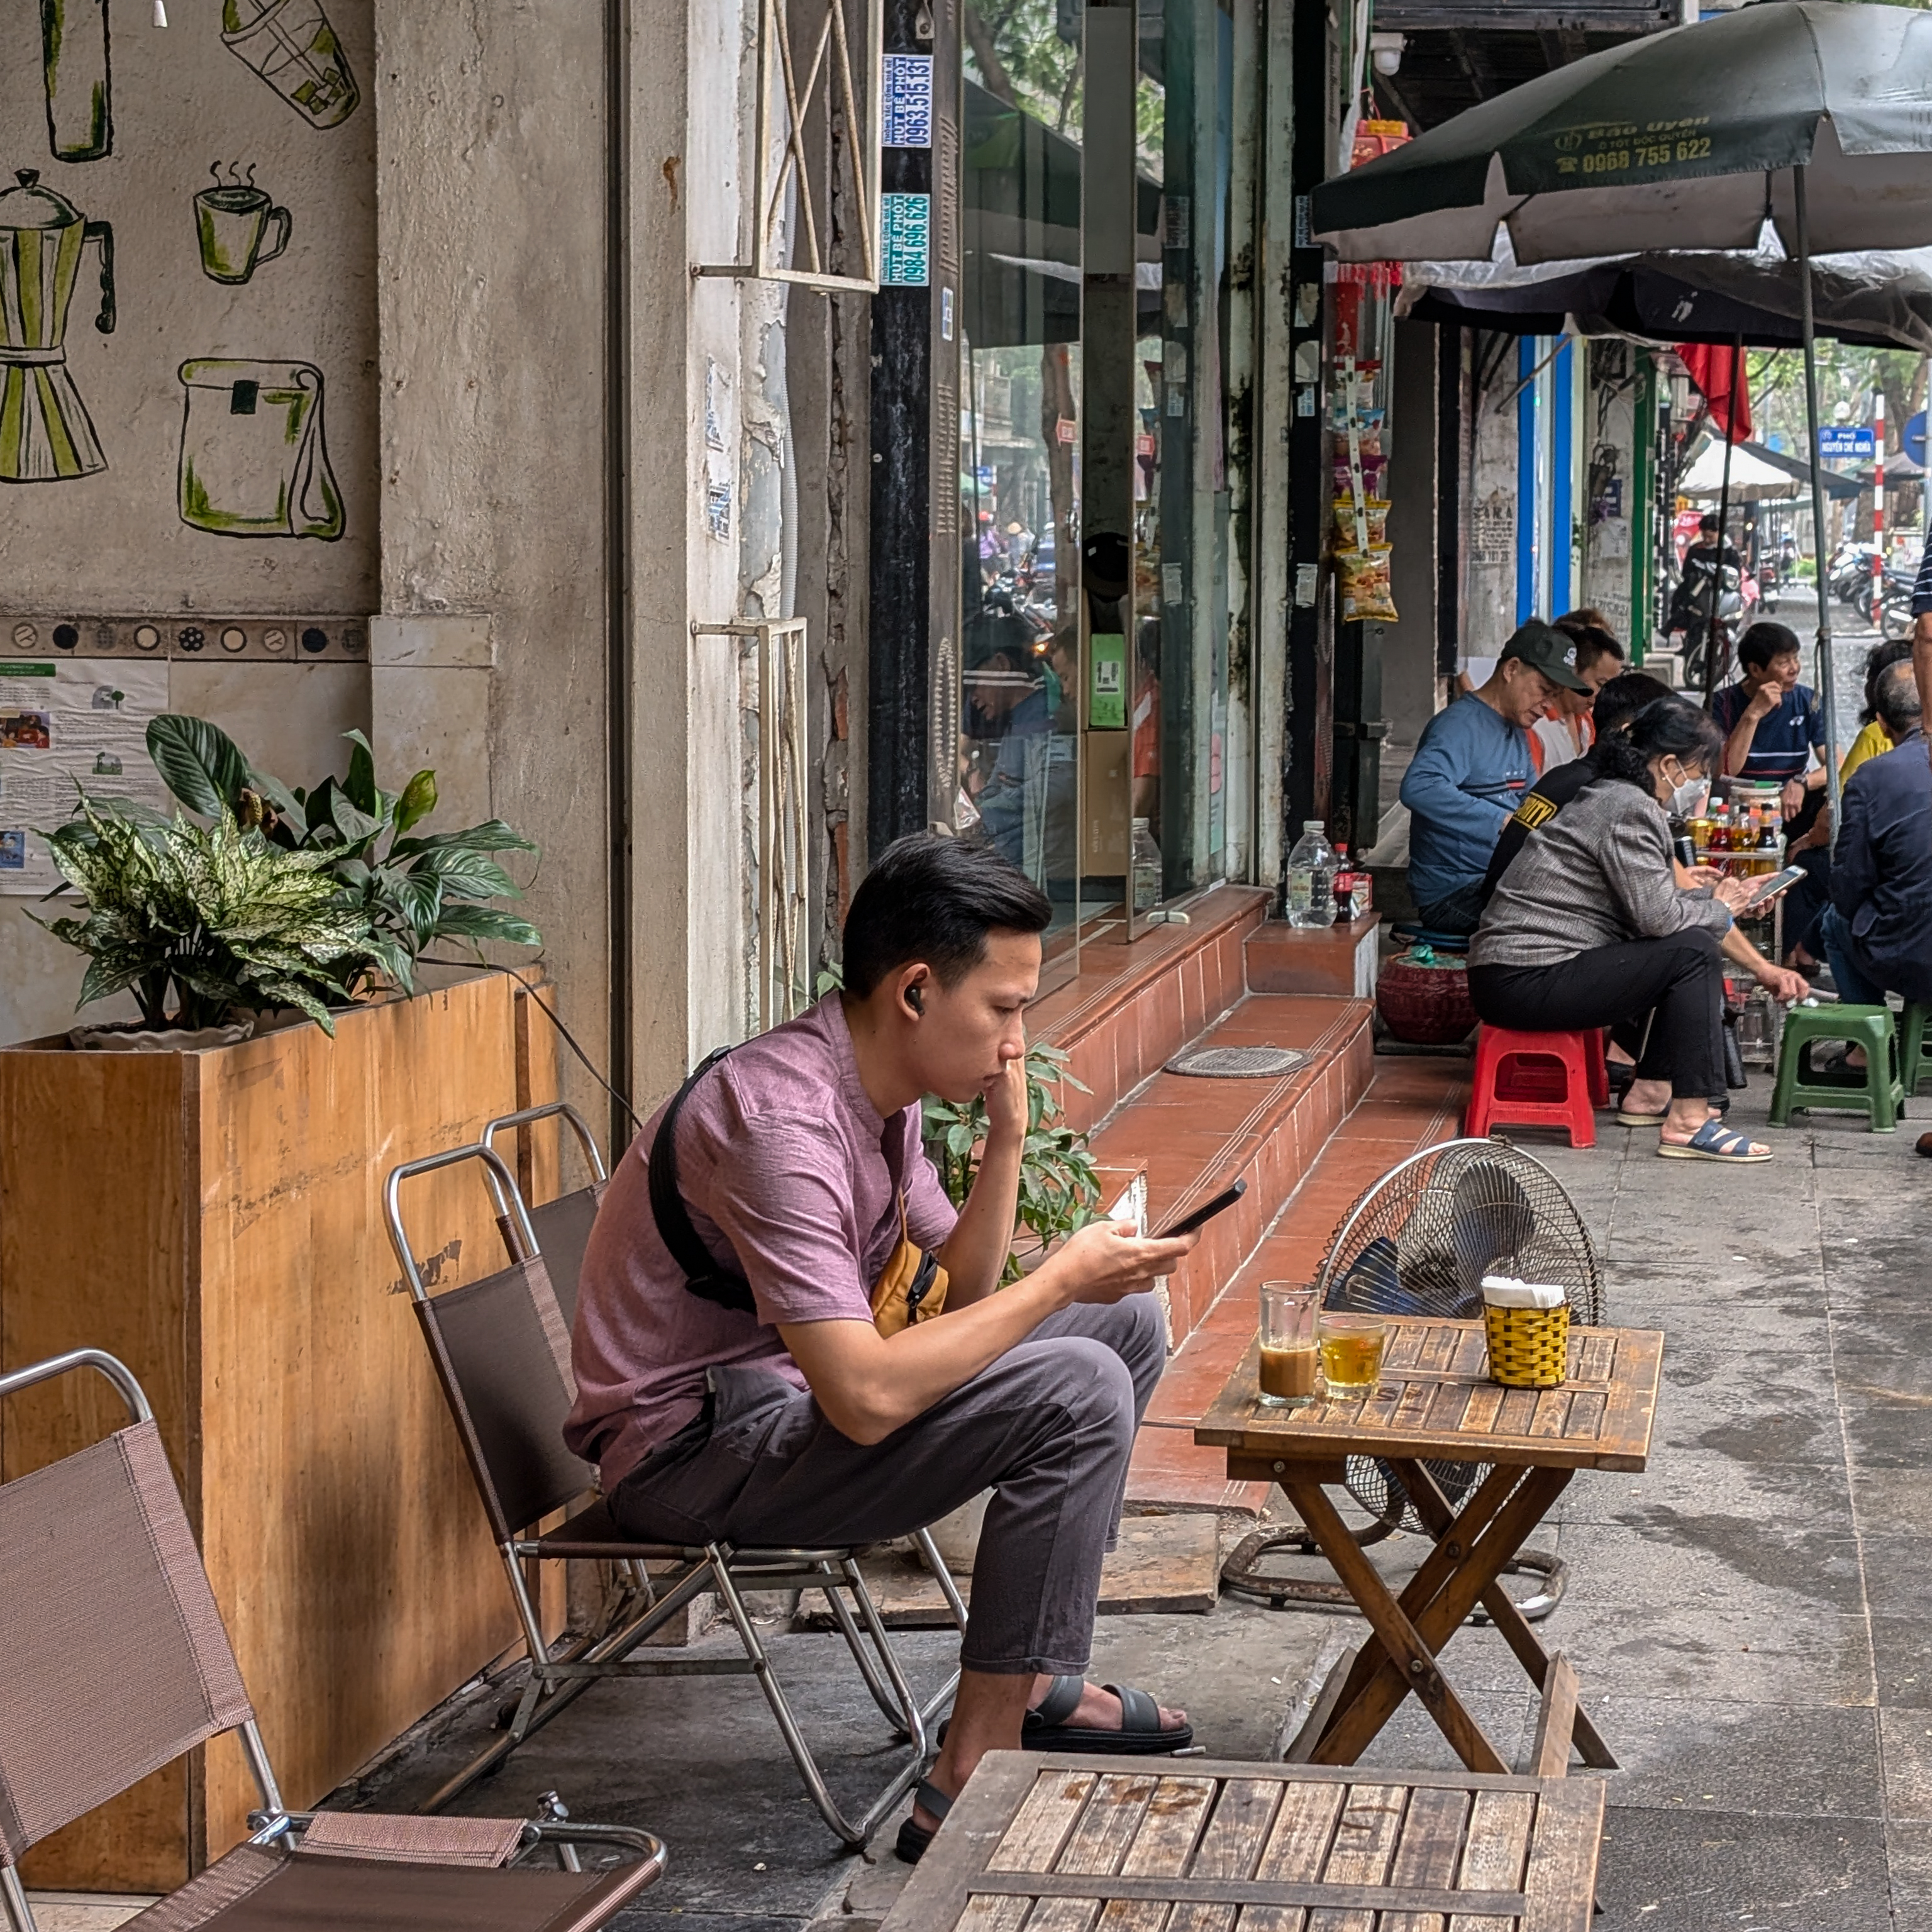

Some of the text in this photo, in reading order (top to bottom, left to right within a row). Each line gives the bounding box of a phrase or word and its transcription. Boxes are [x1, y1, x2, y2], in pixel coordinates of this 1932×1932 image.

[906, 59, 930, 145] 0963.515.131
[1582, 137, 1711, 174] 0968 755 622
[903, 197, 928, 282] 0984.696.626
